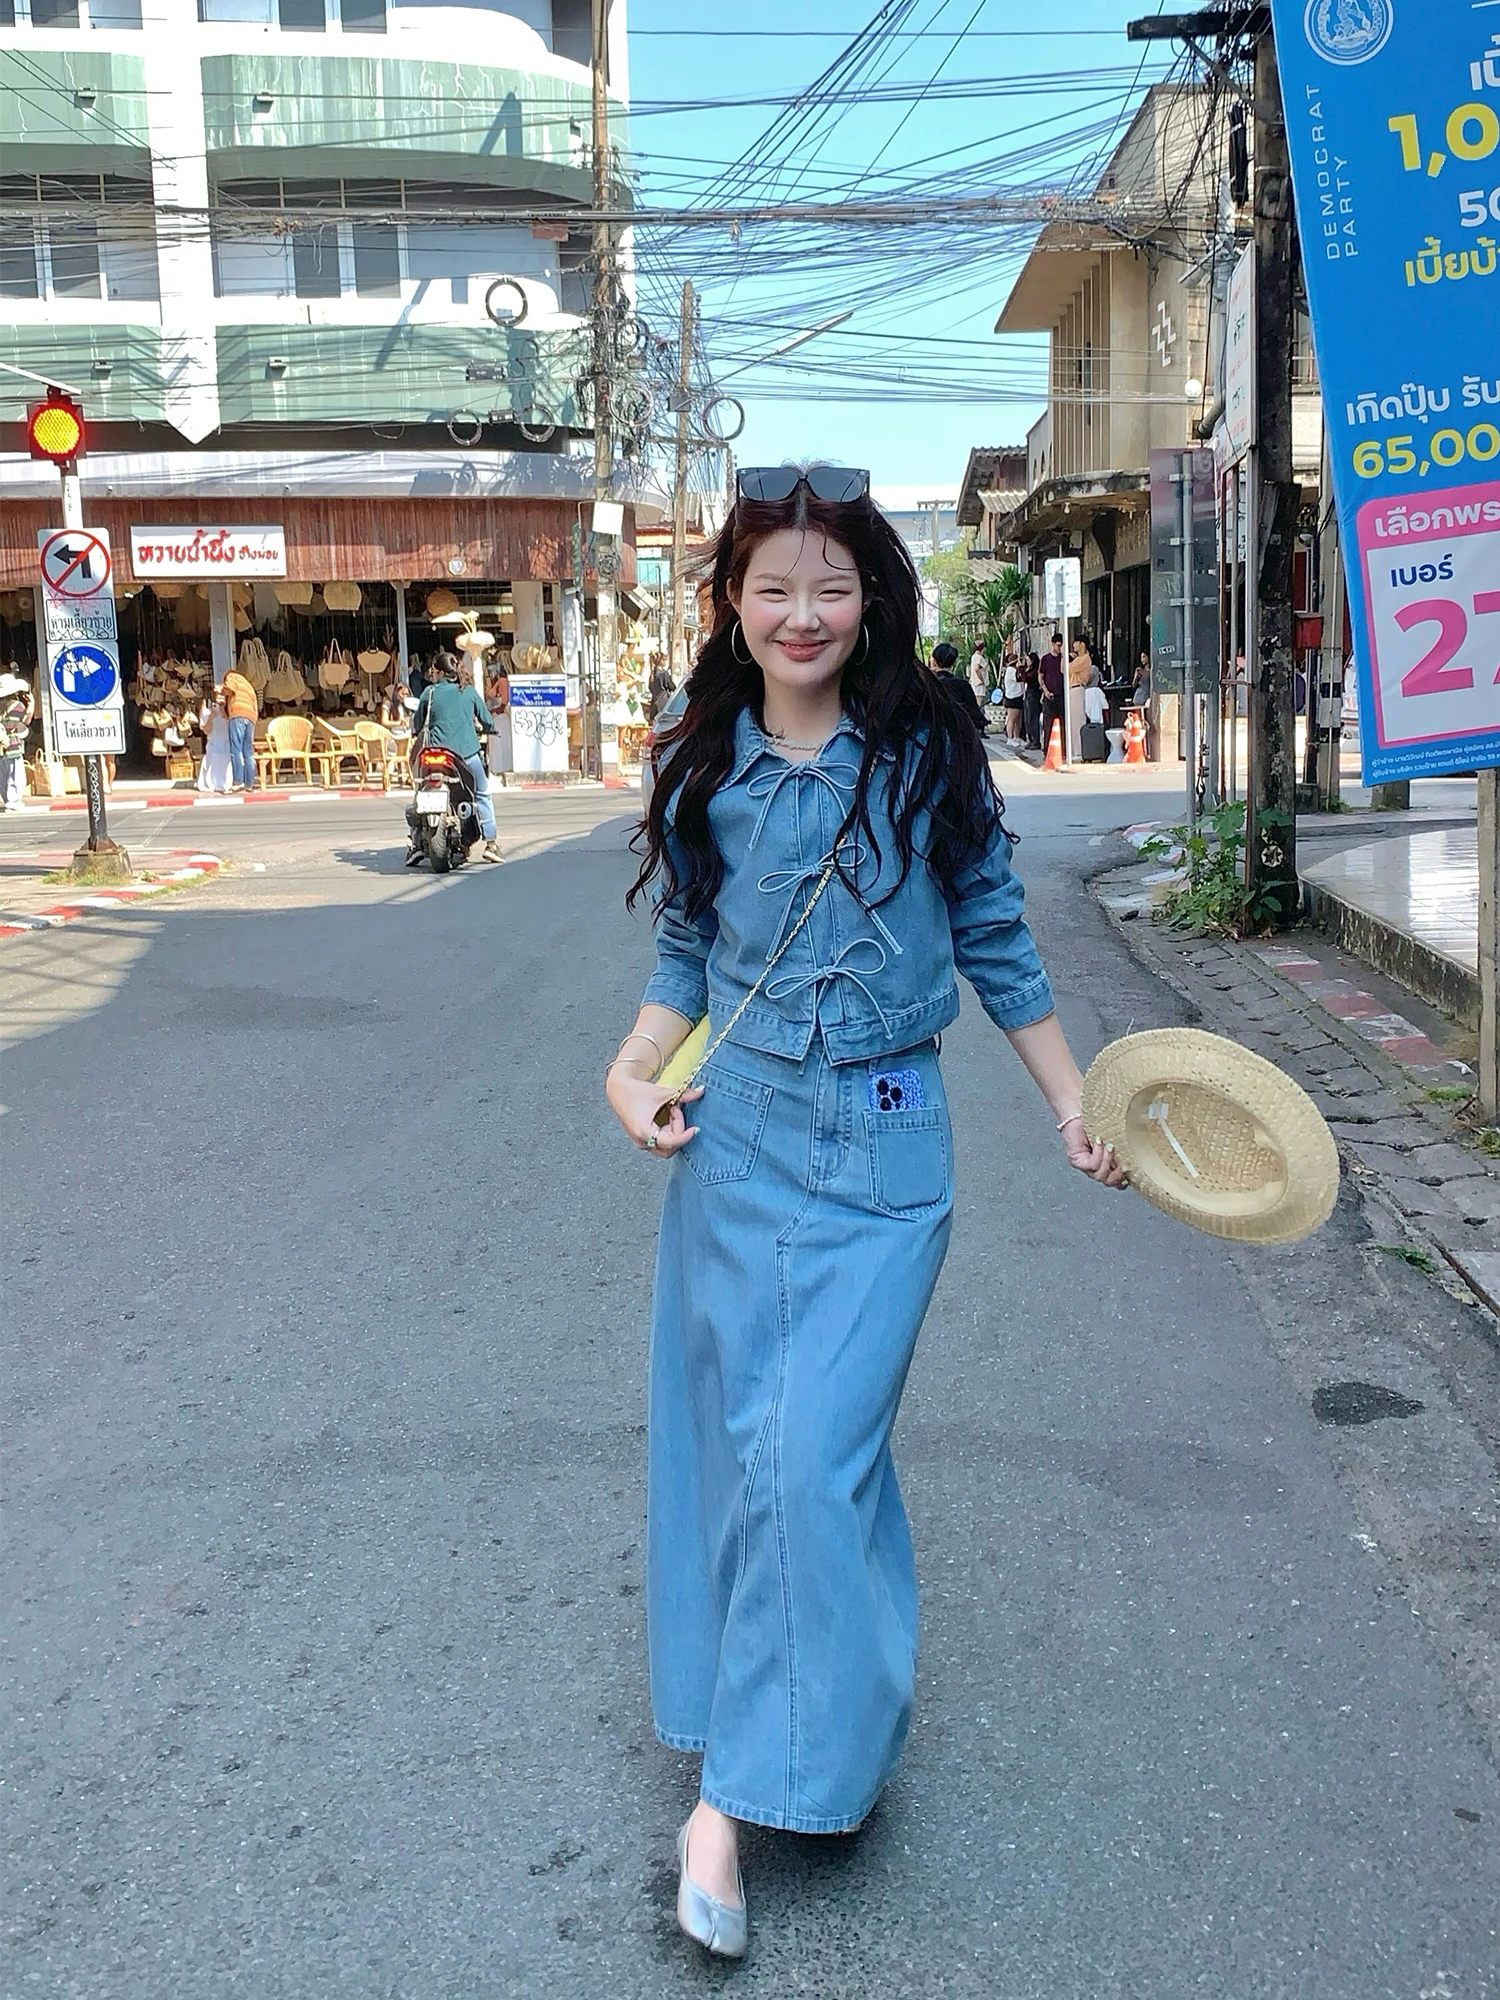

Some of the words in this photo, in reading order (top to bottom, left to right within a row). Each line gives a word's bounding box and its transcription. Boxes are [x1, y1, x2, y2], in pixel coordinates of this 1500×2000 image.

[1305, 84, 1341, 260] DEMOCRAT
[1333, 155, 1359, 258] PARTY
[1346, 382, 1451, 426] เกิดปุ๊บ
[1390, 553, 1454, 588] เบอร์
[50, 607, 113, 631] ห้ามเลี้ยวซ้าย
[63, 718, 117, 738] ให้เลี้ยวขวา
